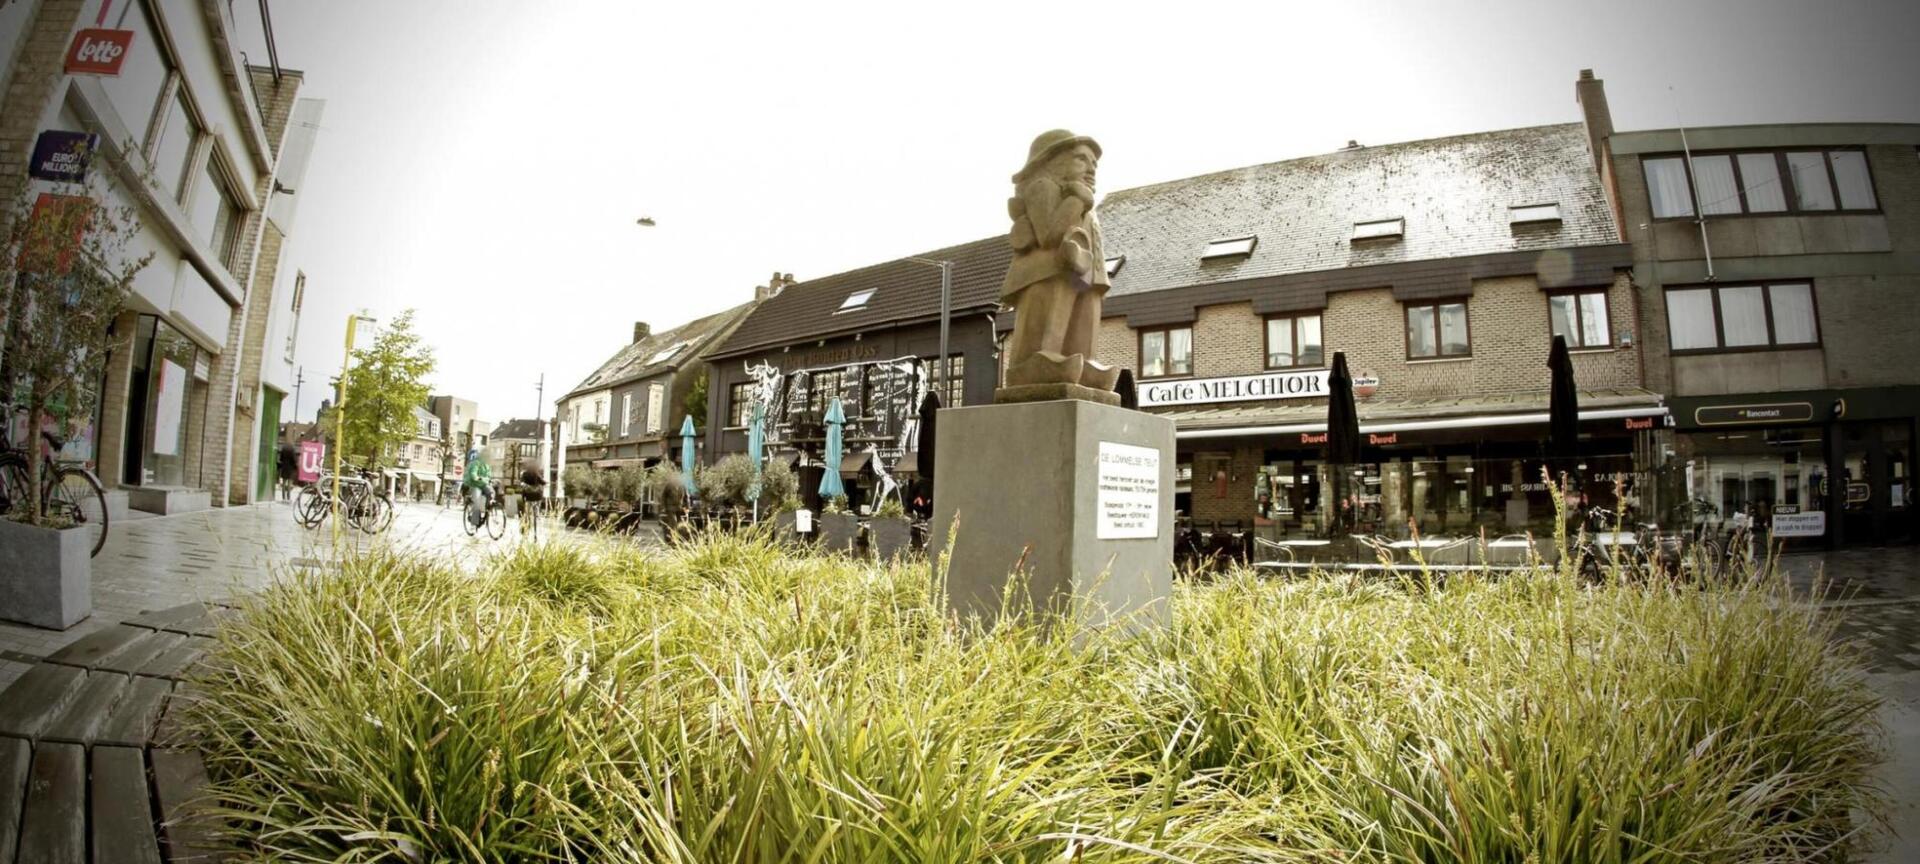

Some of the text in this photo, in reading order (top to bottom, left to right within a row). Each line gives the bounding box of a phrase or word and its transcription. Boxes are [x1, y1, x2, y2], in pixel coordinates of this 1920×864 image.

[51, 152, 73, 163] EURO
[41, 162, 79, 174] MILLIONS
[1148, 374, 1321, 402] Café MELCHIOR
[1746, 409, 1780, 418] Bancontact
[1626, 417, 1653, 429] Duvel
[1301, 432, 1328, 444] Duvel
[1370, 432, 1397, 445] Duvel
